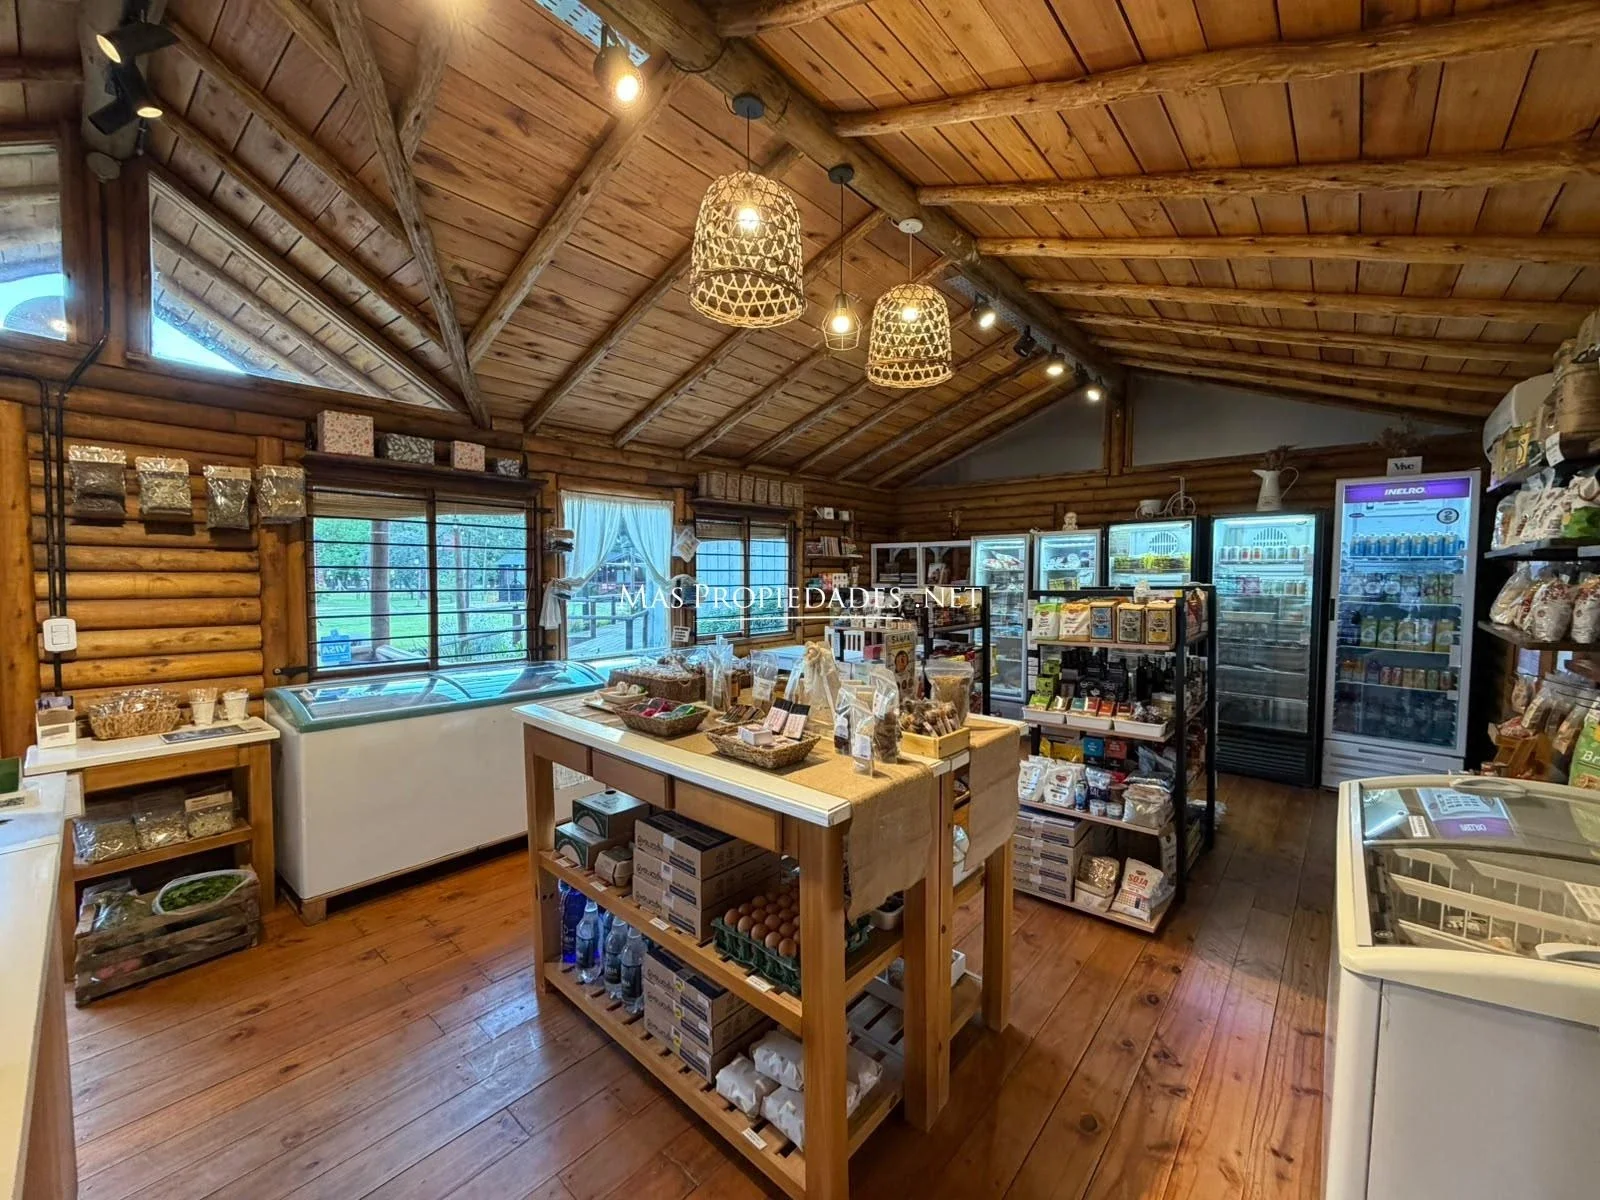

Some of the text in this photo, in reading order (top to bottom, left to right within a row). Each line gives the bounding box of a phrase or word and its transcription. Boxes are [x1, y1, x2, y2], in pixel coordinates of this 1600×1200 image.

[1393, 463, 1415, 471] Vive
[1384, 486, 1425, 496] INELRO
[1127, 873, 1149, 888] SOJA
